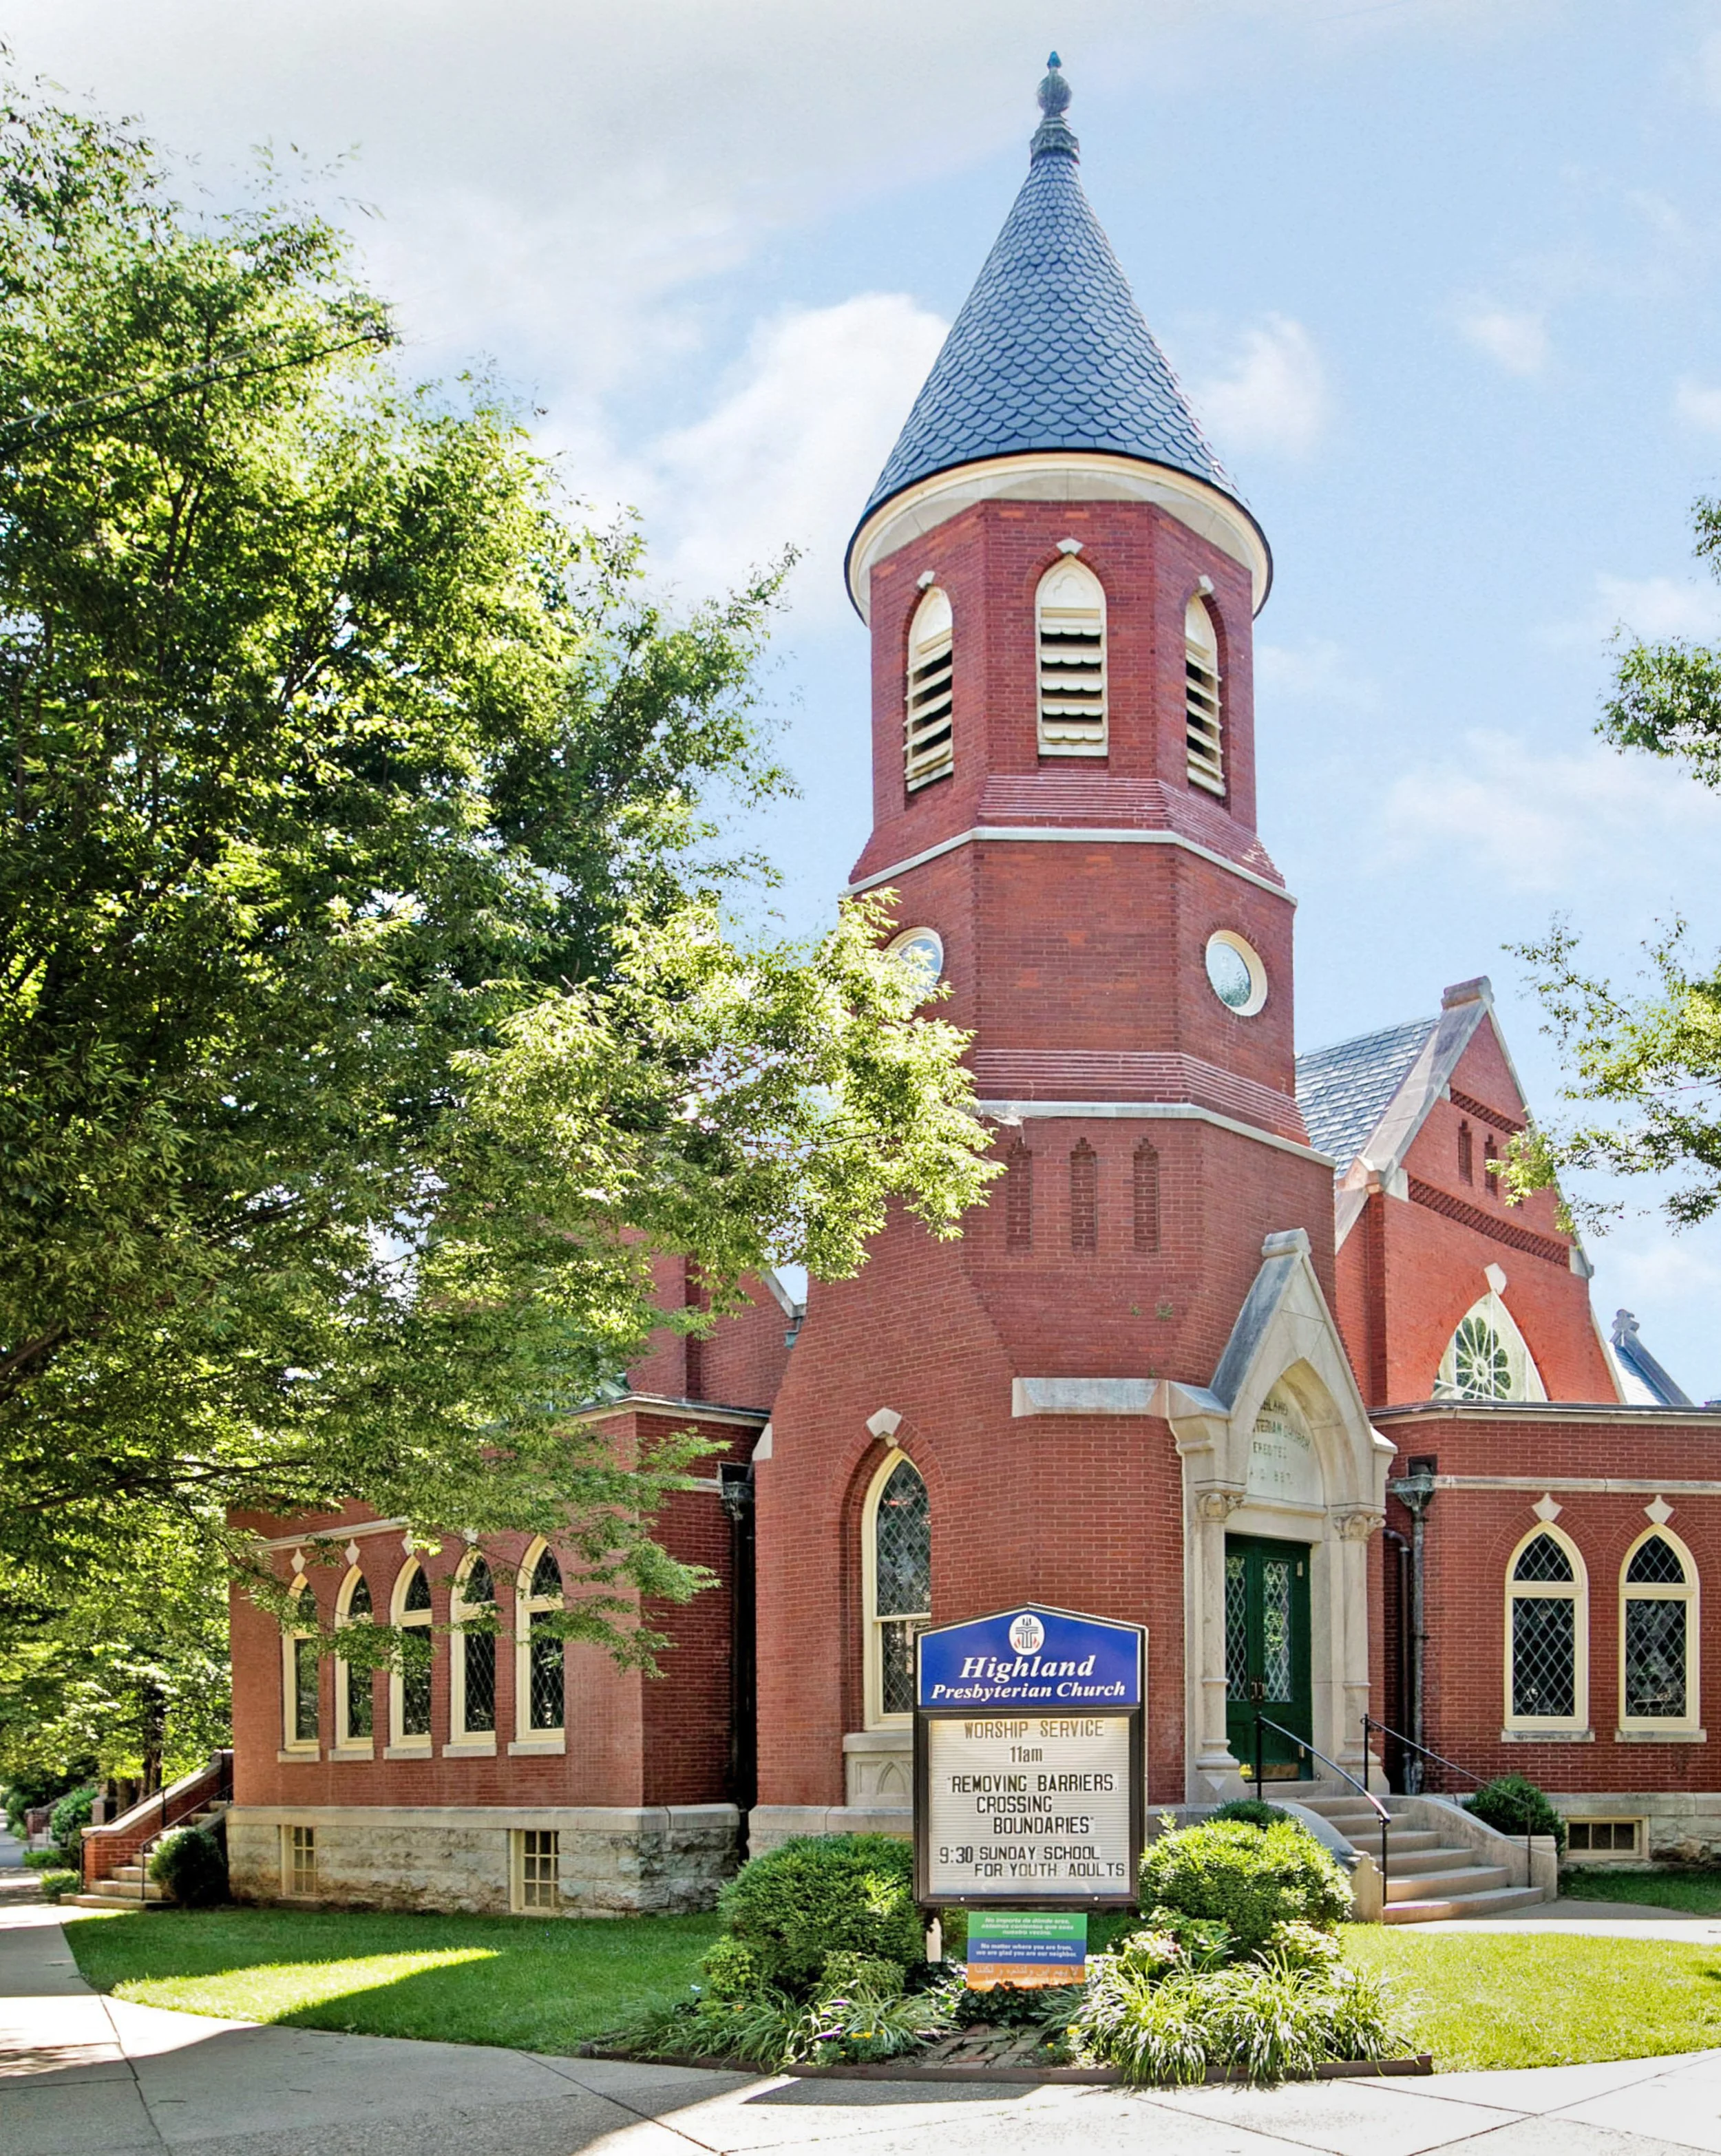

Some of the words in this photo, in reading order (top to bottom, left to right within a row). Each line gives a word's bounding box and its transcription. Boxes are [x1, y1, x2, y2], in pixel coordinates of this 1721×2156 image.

[960, 1655, 1096, 1683] Highland
[931, 1683, 1052, 1702] Presbyterian
[1056, 1681, 1126, 1698] Church
[964, 1720, 1028, 1739] WORSHIP
[1040, 1720, 1104, 1737] SERVICE
[1010, 1746, 1043, 1762] 11am
[976, 1795, 1053, 1814] CROSSING
[939, 1846, 973, 1863] 9:30
[979, 1846, 1036, 1860] SUNDAY
[1044, 1846, 1101, 1860] SCHOOL
[974, 1863, 1003, 1877] FOR
[1010, 1863, 1057, 1877] YOUTH
[1068, 1863, 1126, 1877] ADULTS
